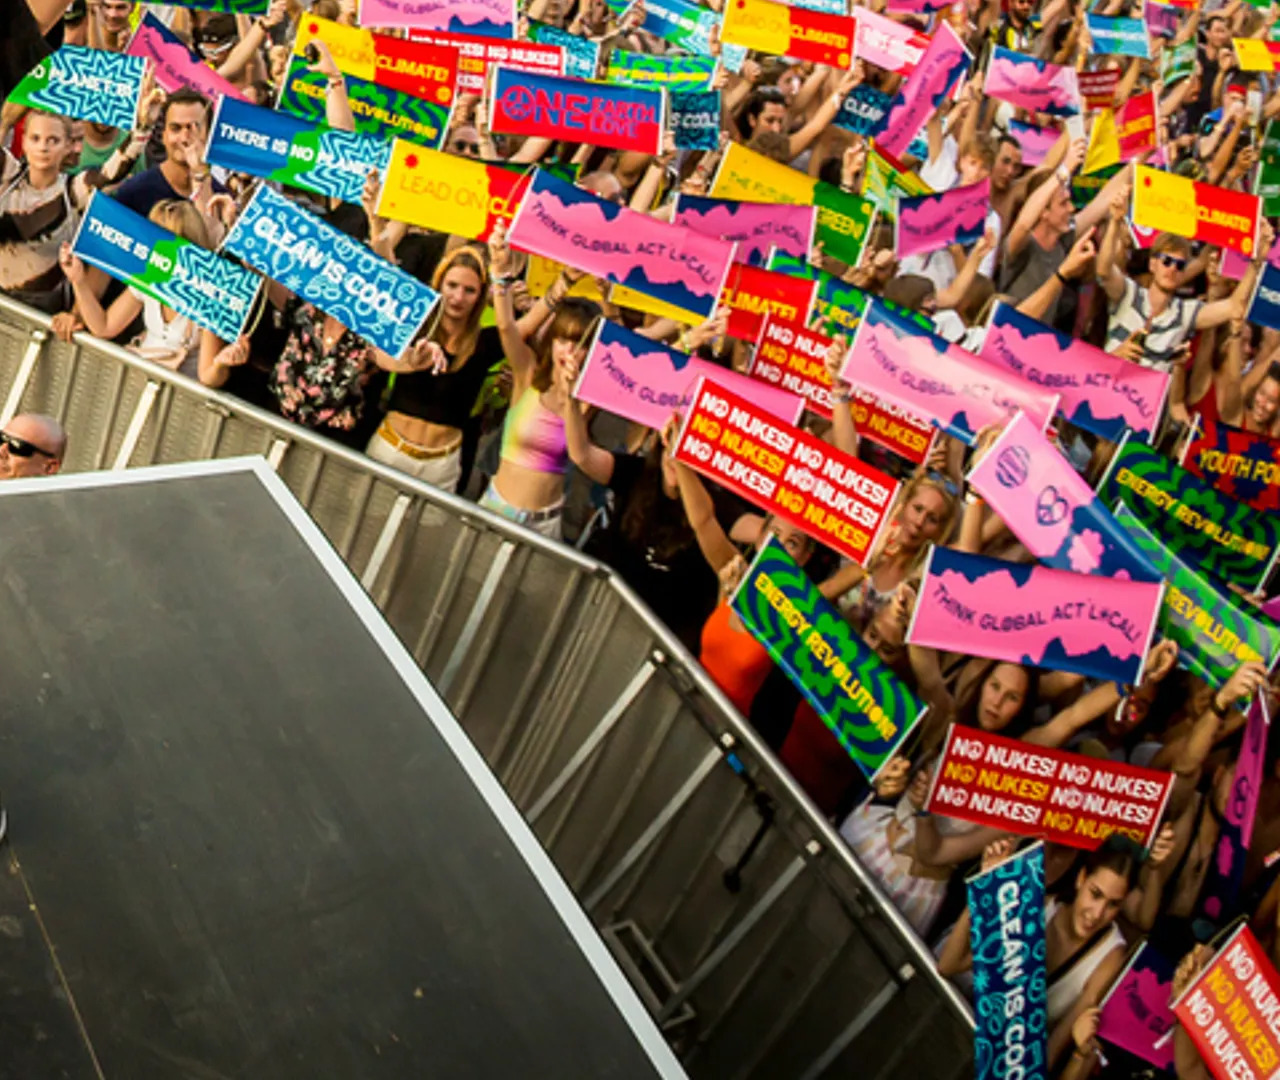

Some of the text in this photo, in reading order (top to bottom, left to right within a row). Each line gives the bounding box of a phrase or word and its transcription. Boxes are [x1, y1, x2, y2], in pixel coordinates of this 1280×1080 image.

[375, 52, 450, 82] CLIMATE!
[591, 98, 656, 124] EARTH
[591, 115, 639, 139] LOVE
[218, 122, 269, 153] THERE
[270, 138, 289, 156] IS
[289, 142, 316, 163] NO
[86, 218, 136, 254] THERE
[135, 242, 149, 261] IS
[149, 251, 173, 273] NO
[530, 201, 568, 239] THINK
[571, 232, 630, 256] GLOBAL
[635, 241, 666, 257] ACT
[253, 216, 412, 324] CLEAN IS COOL!
[761, 342, 789, 364] NO
[767, 323, 792, 347] NO
[699, 389, 890, 506] NO NUKES! NO NUKES!
[1198, 448, 1248, 474] YOUTH
[684, 435, 869, 553] NO NUKES! NO NUKES!
[691, 413, 880, 530] NO NUKES! NO NUKES!
[1115, 467, 1174, 512] ENERGY
[754, 572, 811, 633] ENERGY
[933, 585, 975, 623] THINK
[979, 611, 1044, 633] GLOBAL
[1050, 603, 1086, 622] ACT
[951, 738, 1162, 800] NO NUKES! NO NUKES!
[937, 786, 971, 808] NO
[968, 794, 1042, 824] NUKES!
[1042, 812, 1075, 833] NO
[945, 763, 1154, 824] NO NUKES! NO NUKES!
[996, 880, 1027, 983] CLEAN
[1225, 946, 1255, 981] NO
[1003, 986, 1027, 1018] IS
[1186, 993, 1215, 1028] NO
